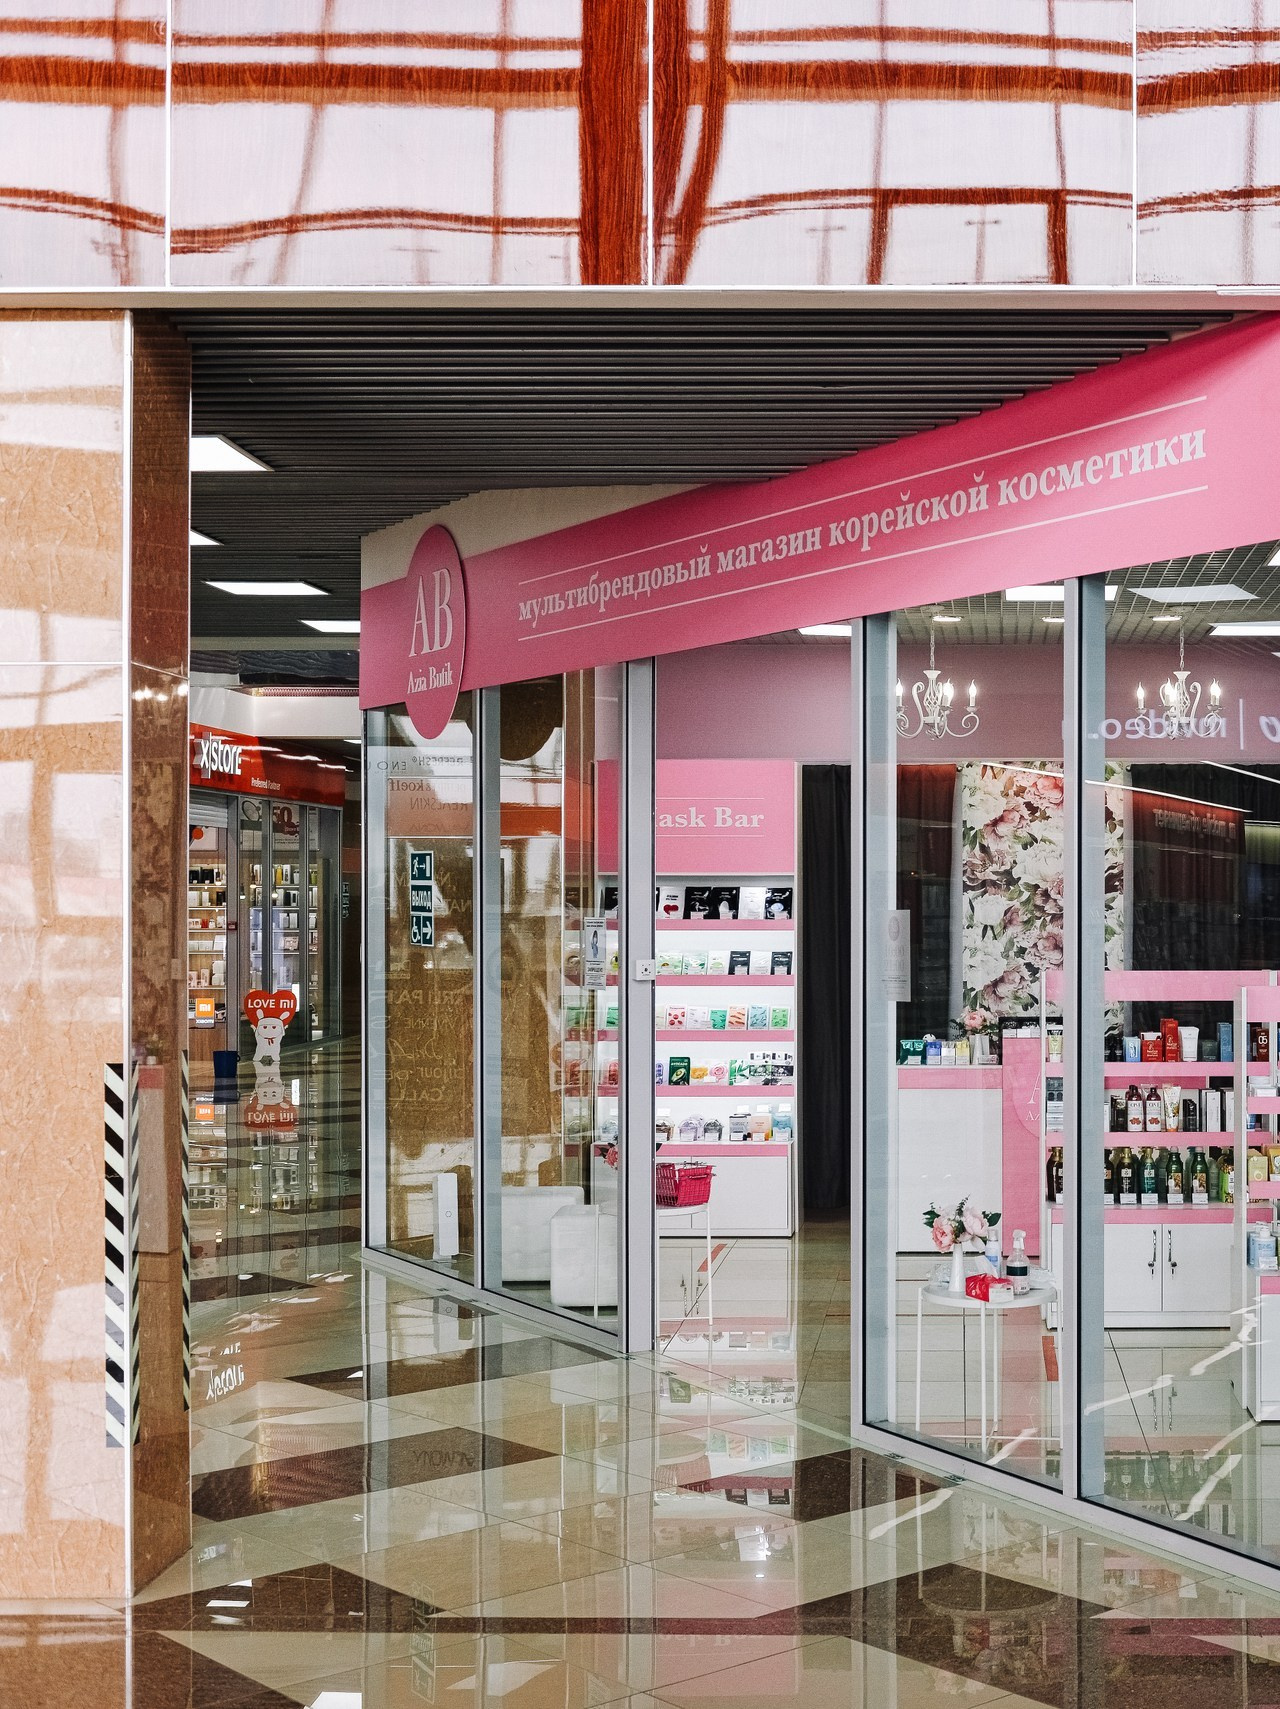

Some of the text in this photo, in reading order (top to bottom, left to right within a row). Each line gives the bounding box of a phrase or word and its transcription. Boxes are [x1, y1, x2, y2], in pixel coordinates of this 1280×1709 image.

[518, 428, 1208, 628] мультибрендовый магазин корейской косметики
[408, 567, 454, 658] AB
[407, 661, 454, 695] Azia Butik
[655, 806, 765, 828] ask Bar
[411, 889, 432, 911] ВЫХОД
[248, 999, 276, 1009] LOVE
